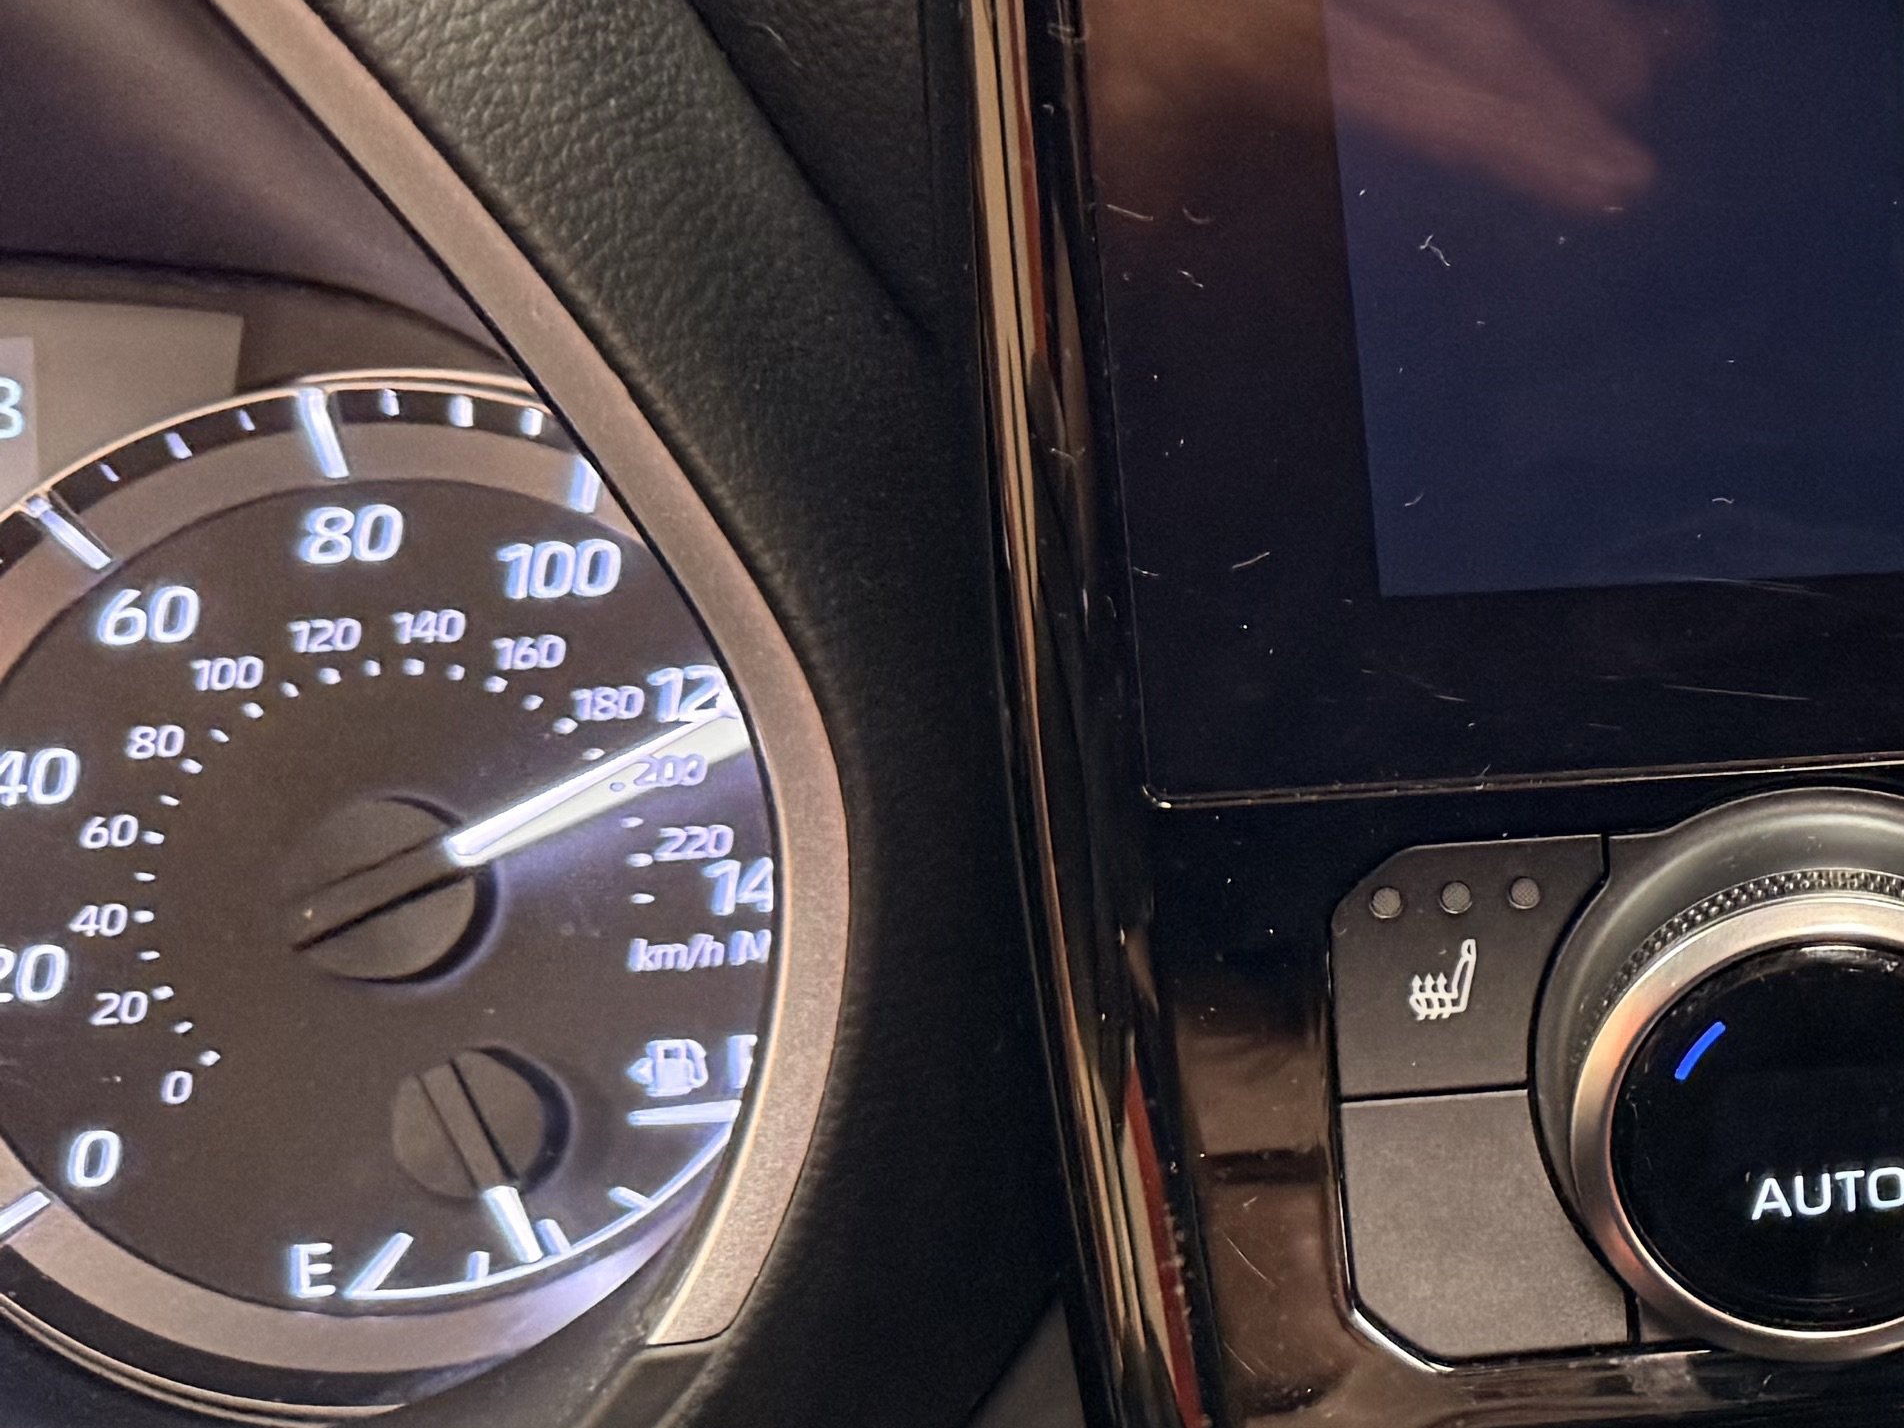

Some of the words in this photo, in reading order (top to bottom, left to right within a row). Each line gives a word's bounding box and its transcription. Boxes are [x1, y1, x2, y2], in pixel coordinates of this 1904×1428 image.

[299, 504, 403, 566] 80
[497, 540, 622, 600] 100
[97, 585, 199, 645] 60
[392, 609, 466, 643] 140
[290, 618, 361, 654] 120
[494, 635, 565, 671] 160
[193, 656, 263, 691] 100
[573, 685, 644, 721] 180
[125, 725, 185, 759] 80
[634, 754, 708, 786] 200
[80, 814, 138, 849] 60
[654, 824, 734, 861] 220
[68, 903, 128, 937] 40
[628, 934, 725, 972] km/h
[90, 991, 149, 1027] 20
[162, 1070, 193, 1104] 0
[68, 1129, 122, 1188] 0
[290, 1242, 334, 1298] E
